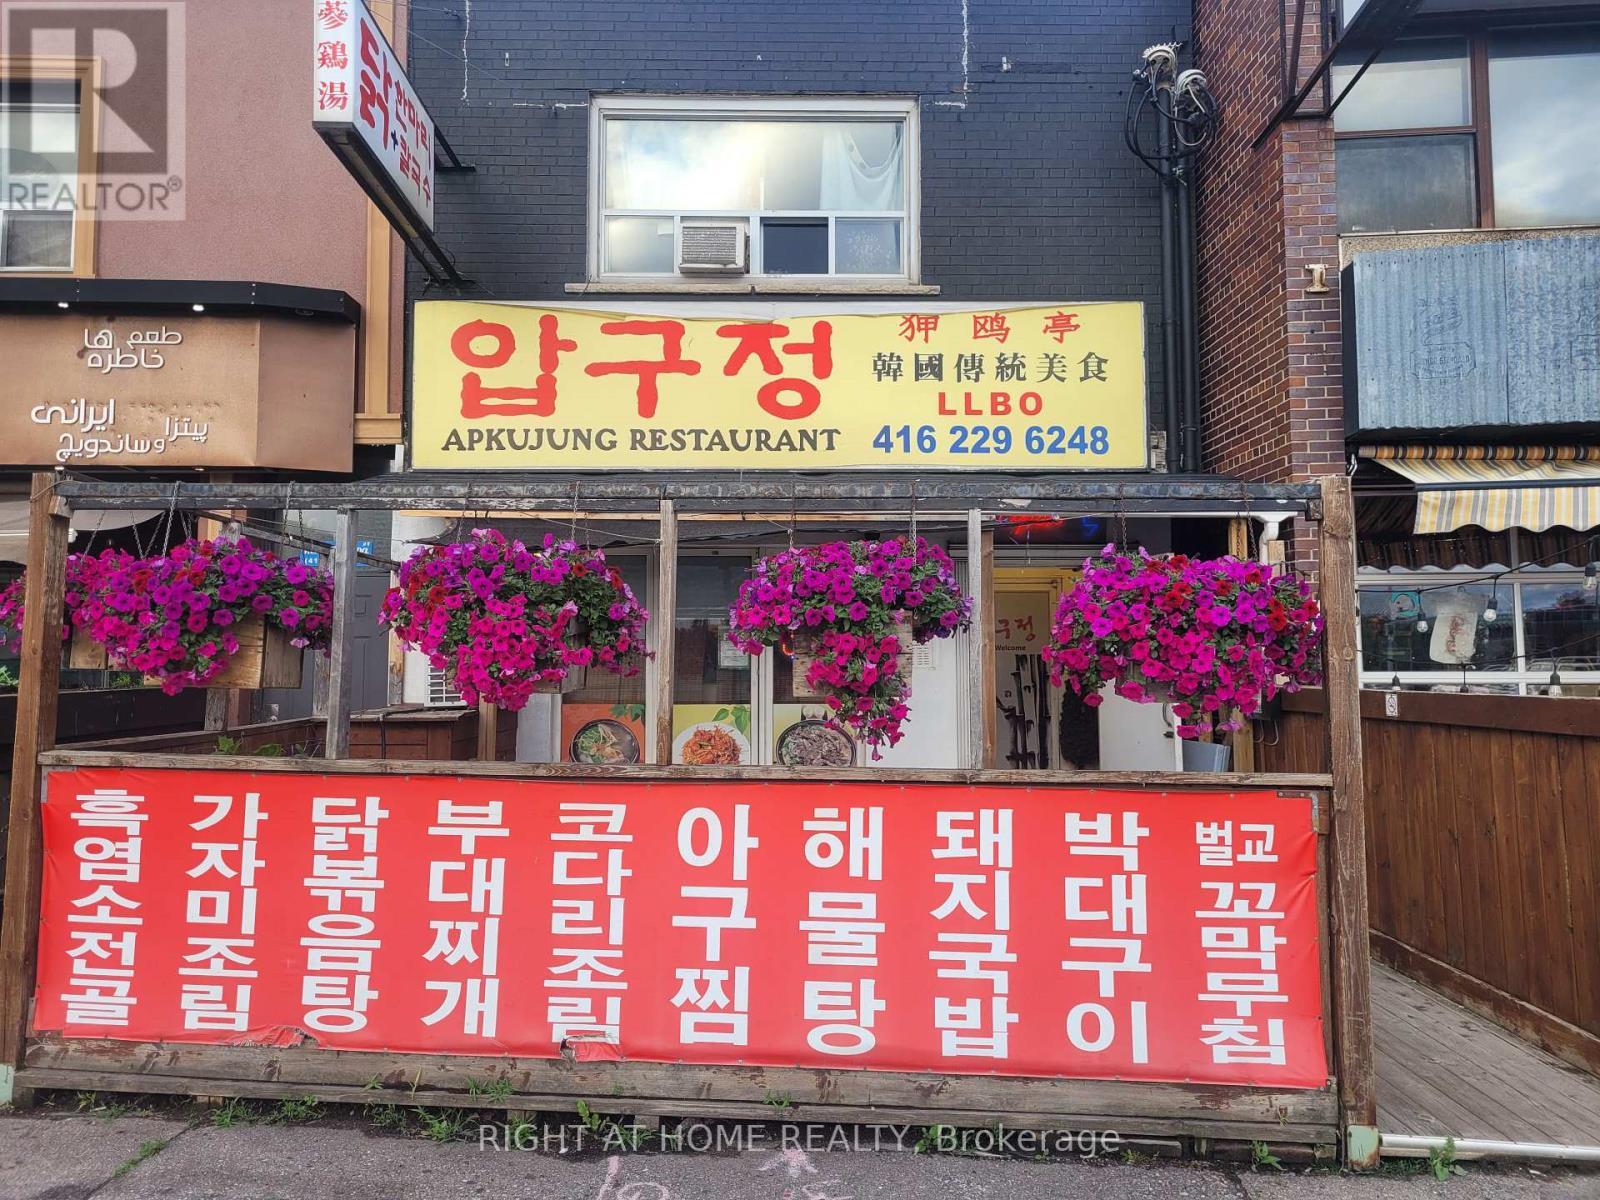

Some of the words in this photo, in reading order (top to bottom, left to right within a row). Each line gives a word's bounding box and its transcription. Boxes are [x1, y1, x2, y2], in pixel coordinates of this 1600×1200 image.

[360, 17, 392, 150] 닭
[395, 79, 430, 171] 한마리
[400, 134, 431, 208] 칼국수
[87, 348, 165, 373] خاطره
[165, 416, 209, 443] پیتزا
[441, 428, 618, 451] APKUJUNG
[630, 428, 841, 451] RESTAURANT
[451, 314, 832, 420] 압구정
[872, 352, 1109, 383] 韓國傳統美食
[873, 425, 937, 454] 416
[949, 425, 1013, 454] 229
[1024, 425, 1110, 455] 6248
[938, 392, 1043, 417] LLBO
[61, 789, 149, 1026] 흑염소전골
[179, 792, 269, 1032] 가자미조림
[300, 796, 389, 1033] 닭볶음탕
[421, 799, 510, 1038] 부대찌개
[544, 803, 633, 1045] 코다리조림
[670, 804, 759, 1046] 아구찜
[1195, 820, 1279, 867] 벌교
[800, 806, 886, 1056] 해물탕
[929, 808, 1018, 1059] 돼지국밥
[1061, 811, 1152, 1064] 박대구이
[1195, 882, 1289, 1066] 꼬막무침
